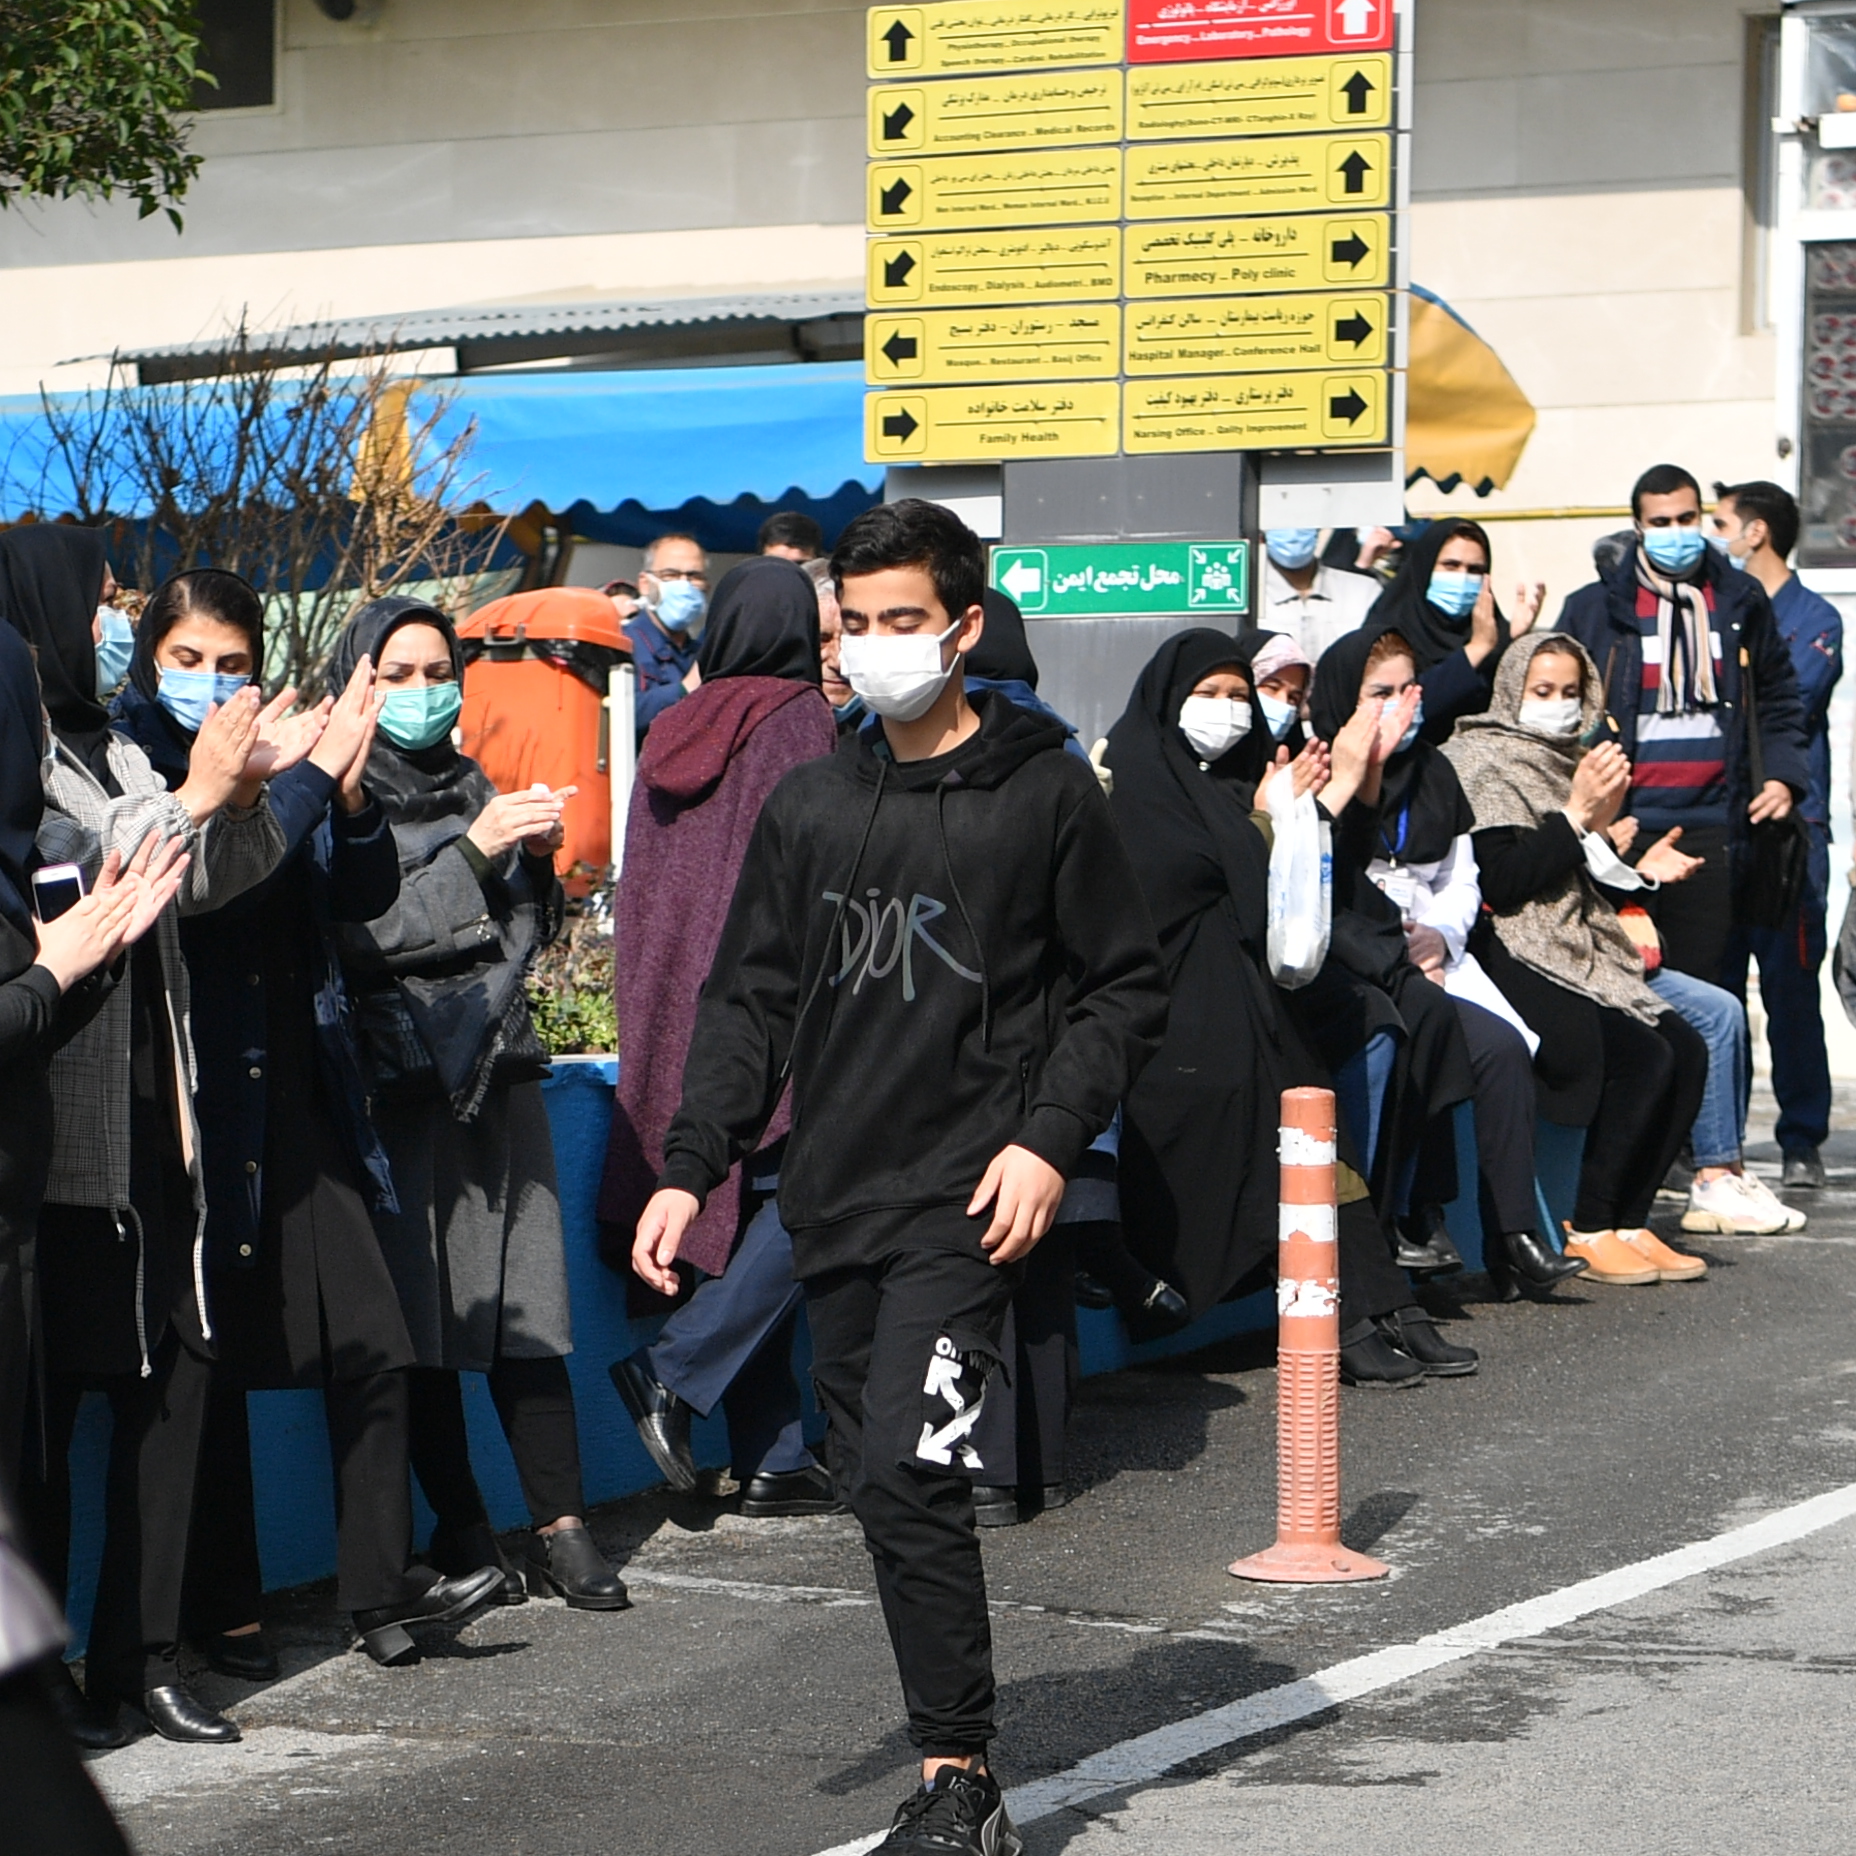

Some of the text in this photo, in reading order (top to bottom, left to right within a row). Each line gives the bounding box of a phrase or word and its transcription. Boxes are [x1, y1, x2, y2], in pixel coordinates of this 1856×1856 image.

[1252, 225, 1297, 248] داروخانه
[1231, 267, 1259, 282] Poly
[1263, 266, 1297, 279] clinic
[1232, 345, 1296, 357] Conference
[1299, 343, 1321, 353] Hall
[967, 396, 1074, 418] دفتر سلامت خانواده
[980, 431, 1060, 445] Family Health
[1052, 563, 1180, 593] محل تجمع ایمن
